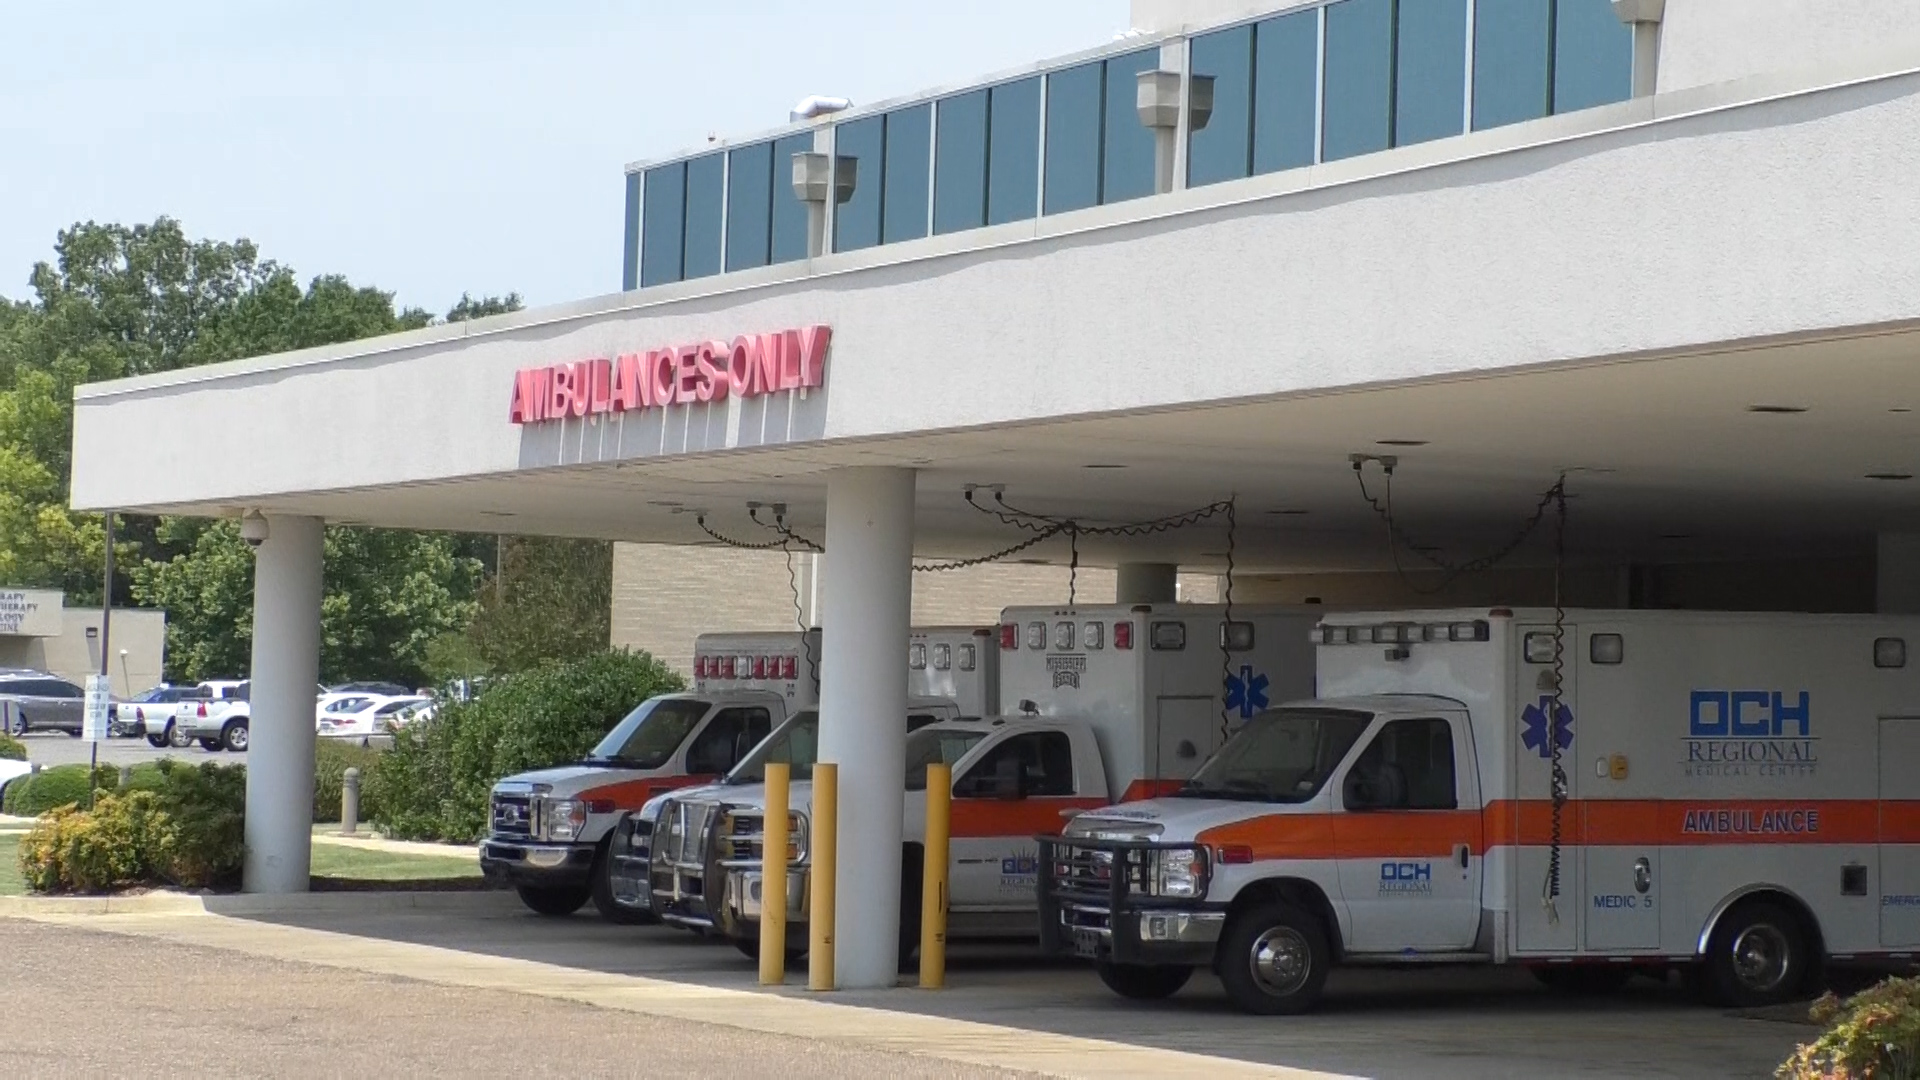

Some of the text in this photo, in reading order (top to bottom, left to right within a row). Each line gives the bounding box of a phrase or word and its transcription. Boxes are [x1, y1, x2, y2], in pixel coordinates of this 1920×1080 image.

[509, 324, 833, 424] AMBULANCES ONLY
[1690, 690, 1810, 736] OCH
[1687, 741, 1818, 762] REGIONAL
[1685, 765, 1816, 777] MEDICAL CENTER
[1683, 809, 1819, 833] AMBULANCE
[1381, 863, 1431, 880] OCH
[1594, 895, 1652, 908] MEDIC 5
